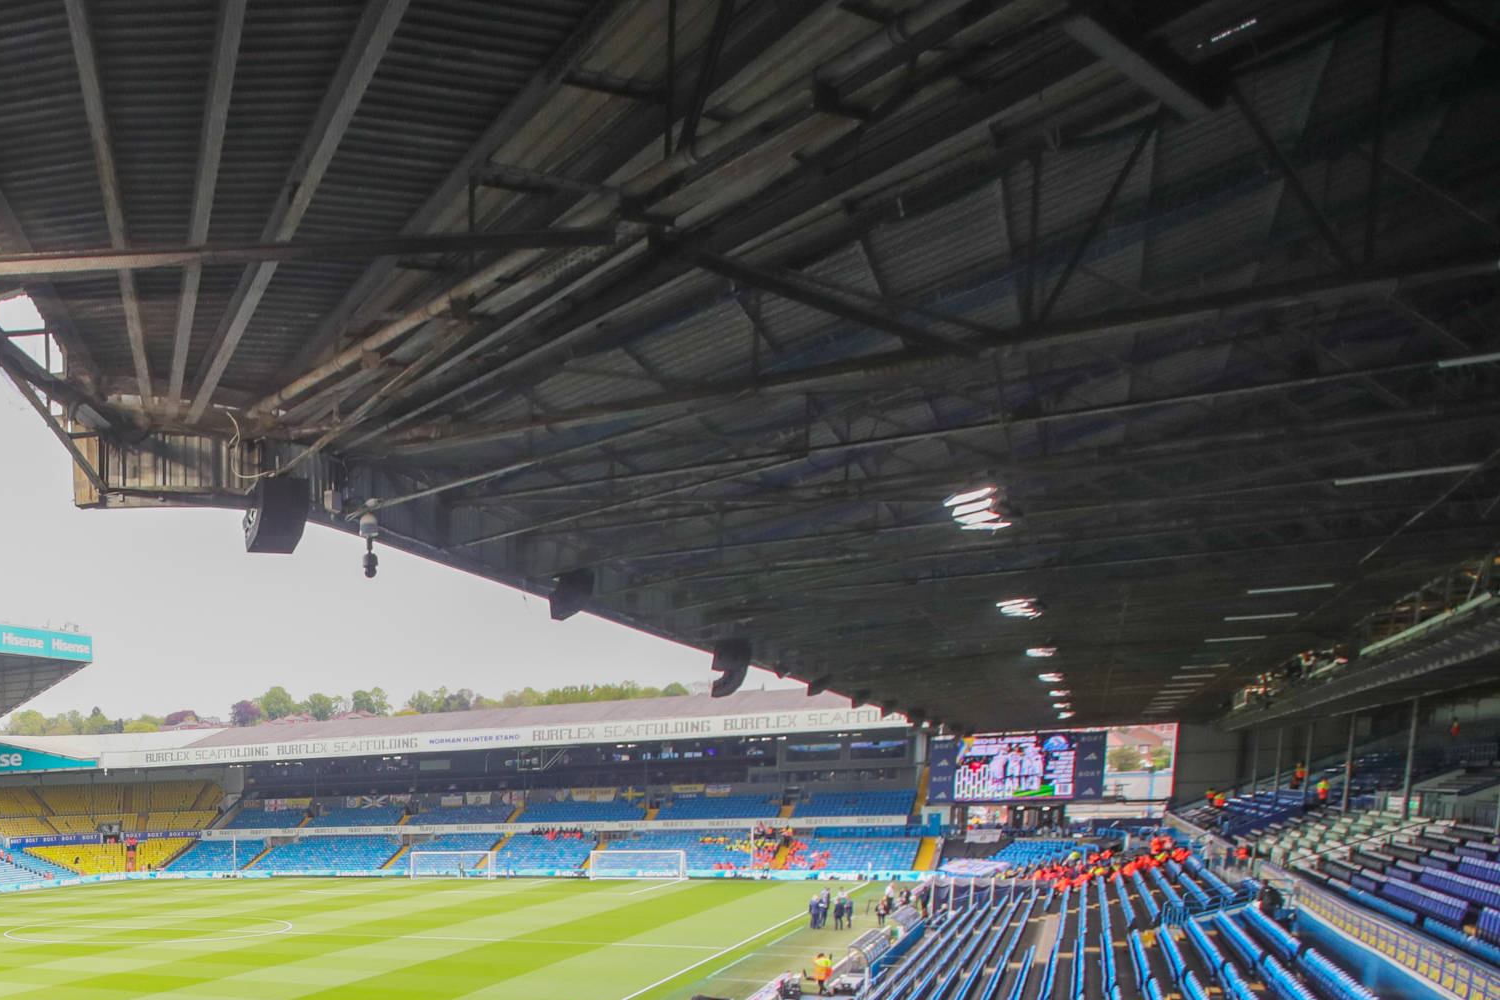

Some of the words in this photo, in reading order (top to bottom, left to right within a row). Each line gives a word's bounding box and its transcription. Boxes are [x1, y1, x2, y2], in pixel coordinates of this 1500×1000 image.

[2, 631, 44, 650] Hisense
[51, 637, 90, 655] Hisense
[723, 714, 797, 732] BURFLEX
[429, 737, 461, 745] NORMAN
[463, 735, 494, 744] HUNTER
[495, 733, 520, 741] STAND
[532, 726, 596, 742] BURFLEX
[145, 750, 190, 763] BURFLEX
[277, 742, 329, 756] BURFLEX
